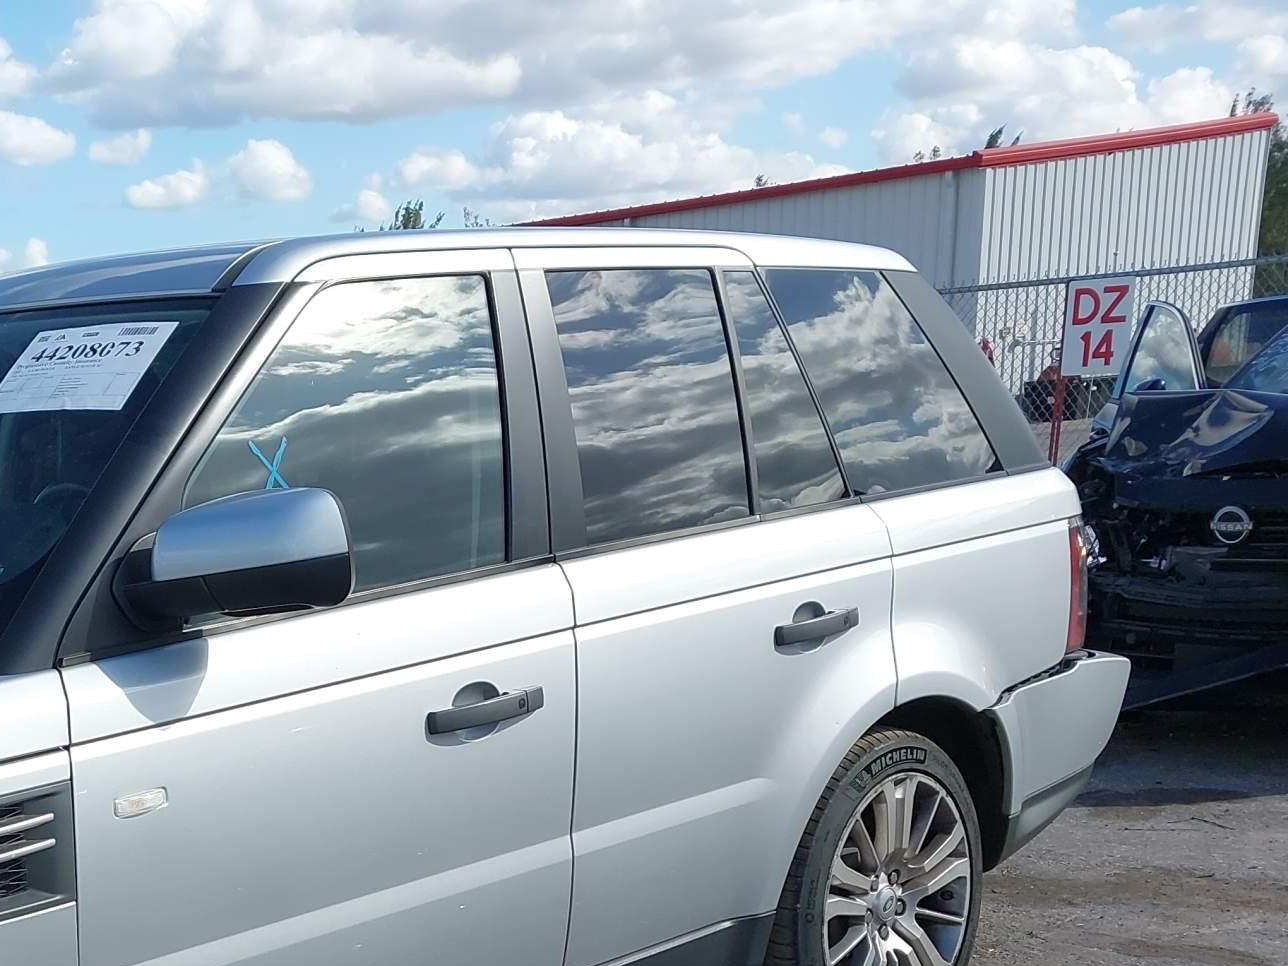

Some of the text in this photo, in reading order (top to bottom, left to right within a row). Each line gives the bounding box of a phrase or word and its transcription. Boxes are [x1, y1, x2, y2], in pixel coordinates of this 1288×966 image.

[1072, 284, 1130, 325] DZ
[1080, 329, 1114, 367] 14
[1210, 521, 1254, 530] NISSAN
[871, 748, 927, 774] MICHELIN
